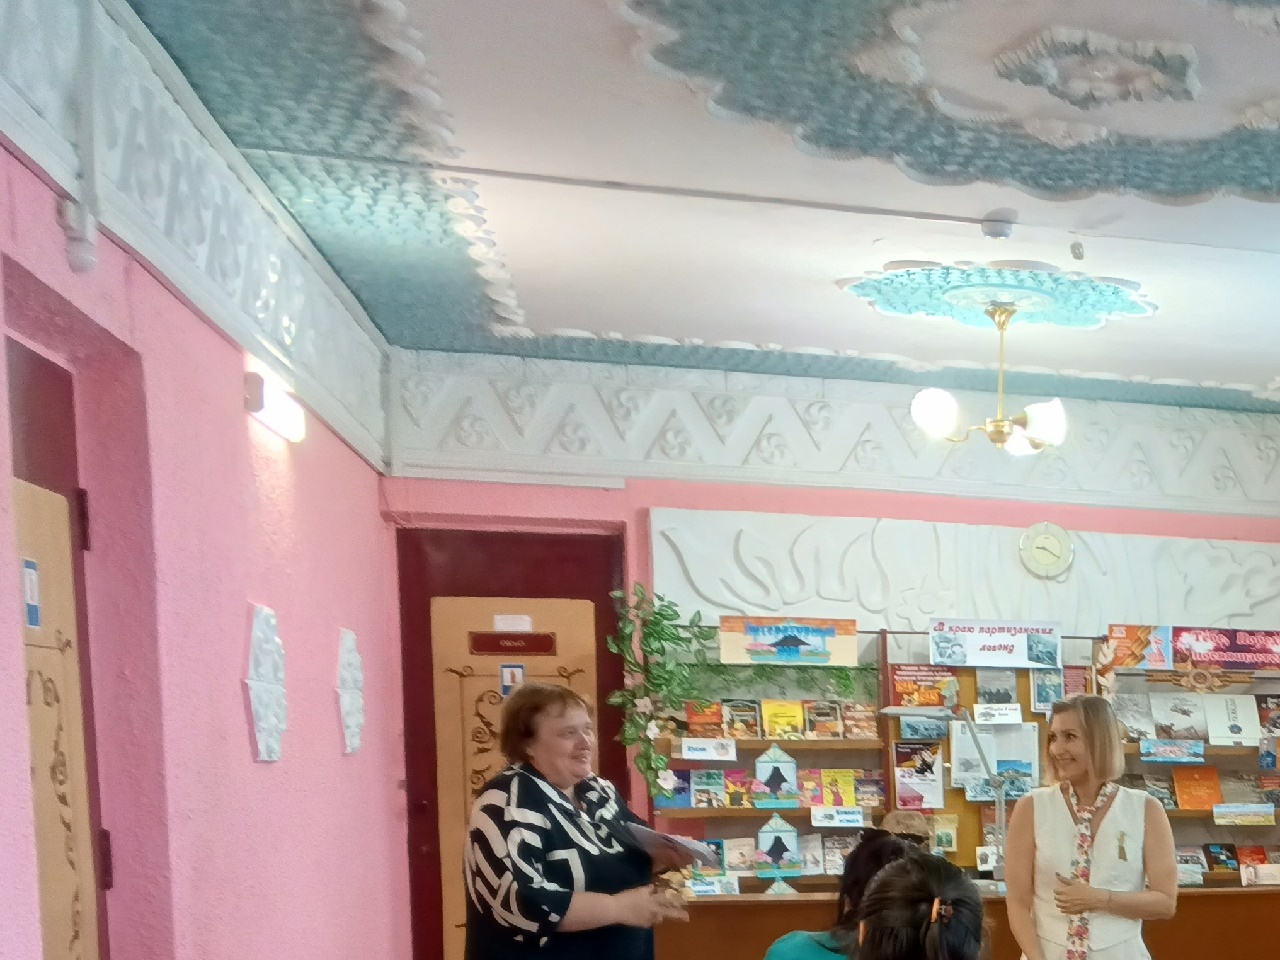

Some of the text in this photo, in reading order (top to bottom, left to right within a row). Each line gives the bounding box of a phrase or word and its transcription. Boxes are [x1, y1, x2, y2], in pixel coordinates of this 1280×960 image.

[933, 621, 1054, 637] В краю партизанских
[979, 643, 1015, 655] легенд
